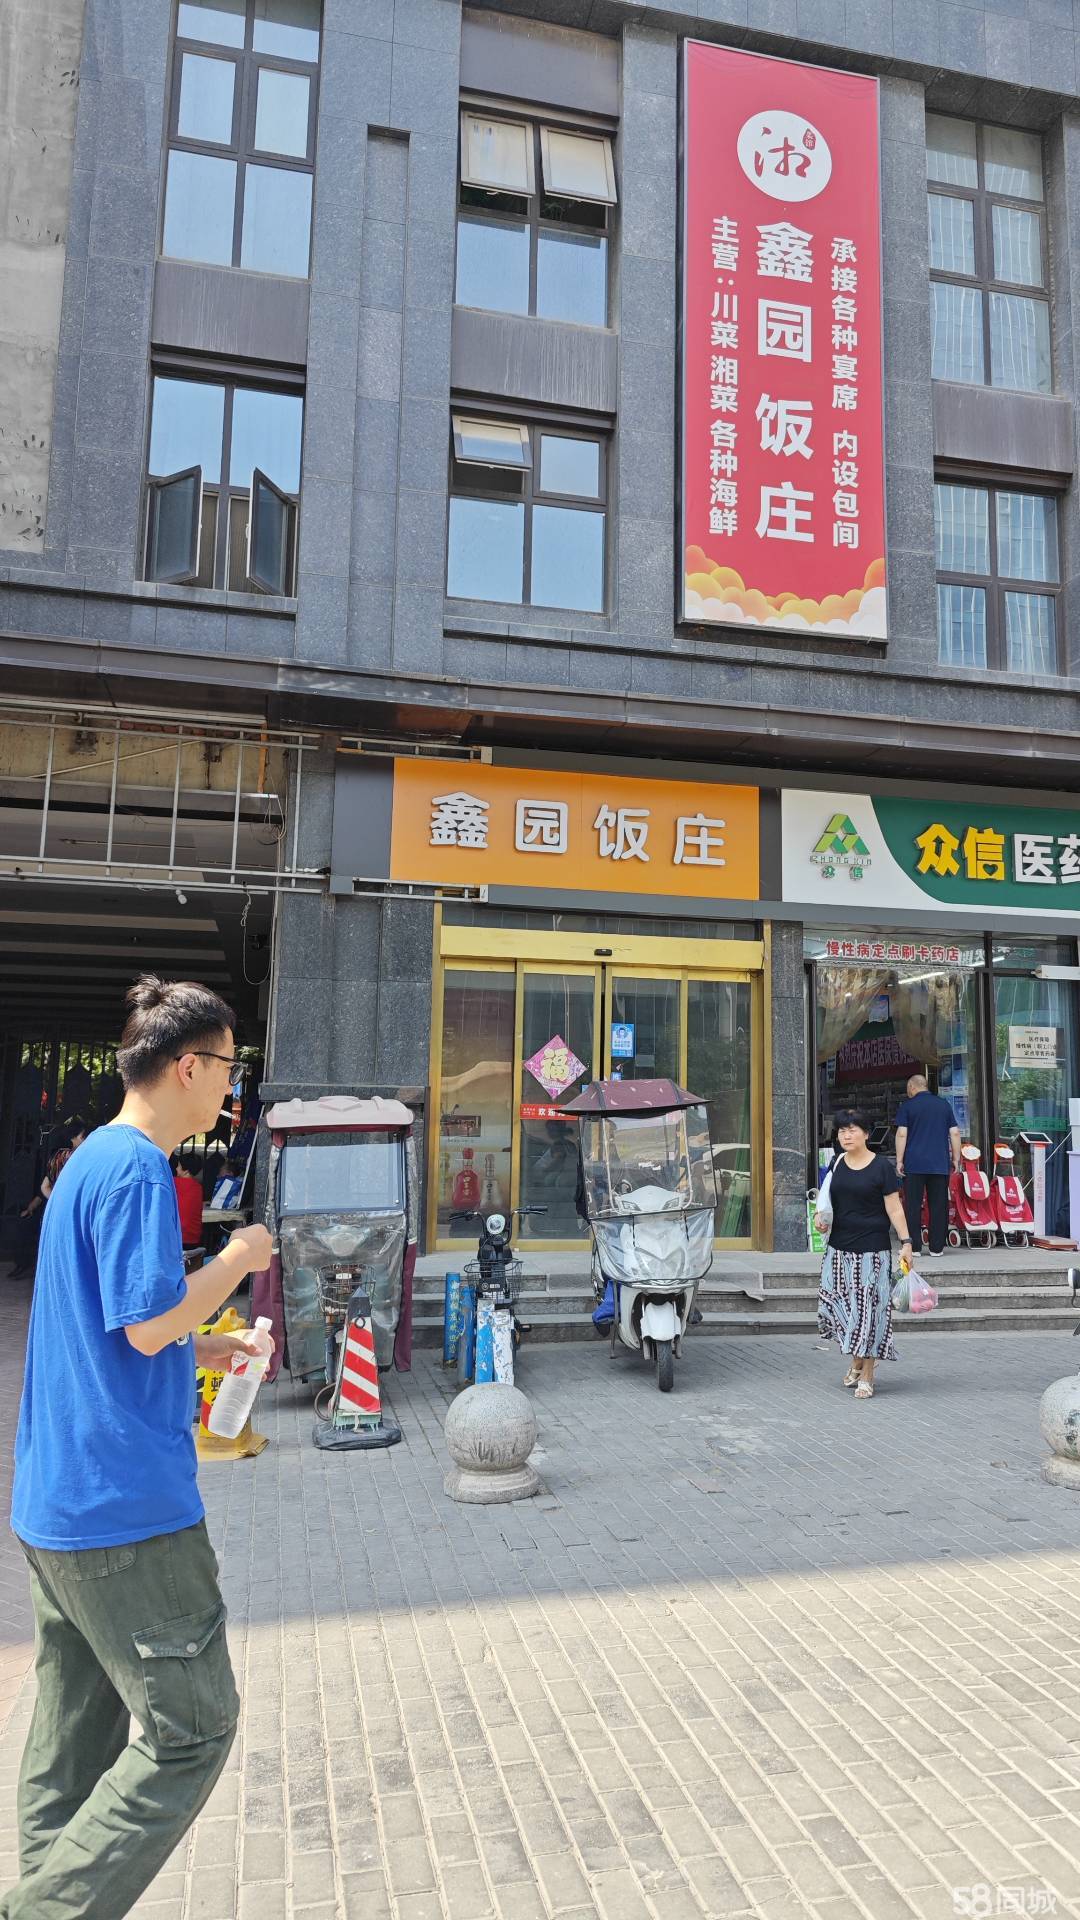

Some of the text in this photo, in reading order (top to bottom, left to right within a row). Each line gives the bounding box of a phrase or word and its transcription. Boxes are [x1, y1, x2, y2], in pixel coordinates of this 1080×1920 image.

[709, 354, 739, 414] 湘菜
[754, 221, 815, 543] 鑫园饭庄
[830, 236, 860, 550] 承接各种宴席 内设包间
[708, 419, 739, 537] 各种海鲜
[429, 791, 727, 866] 鑫园饭庄
[826, 940, 960, 962] 慢性病定点刷卡药店
[541, 1047, 570, 1082] 福
